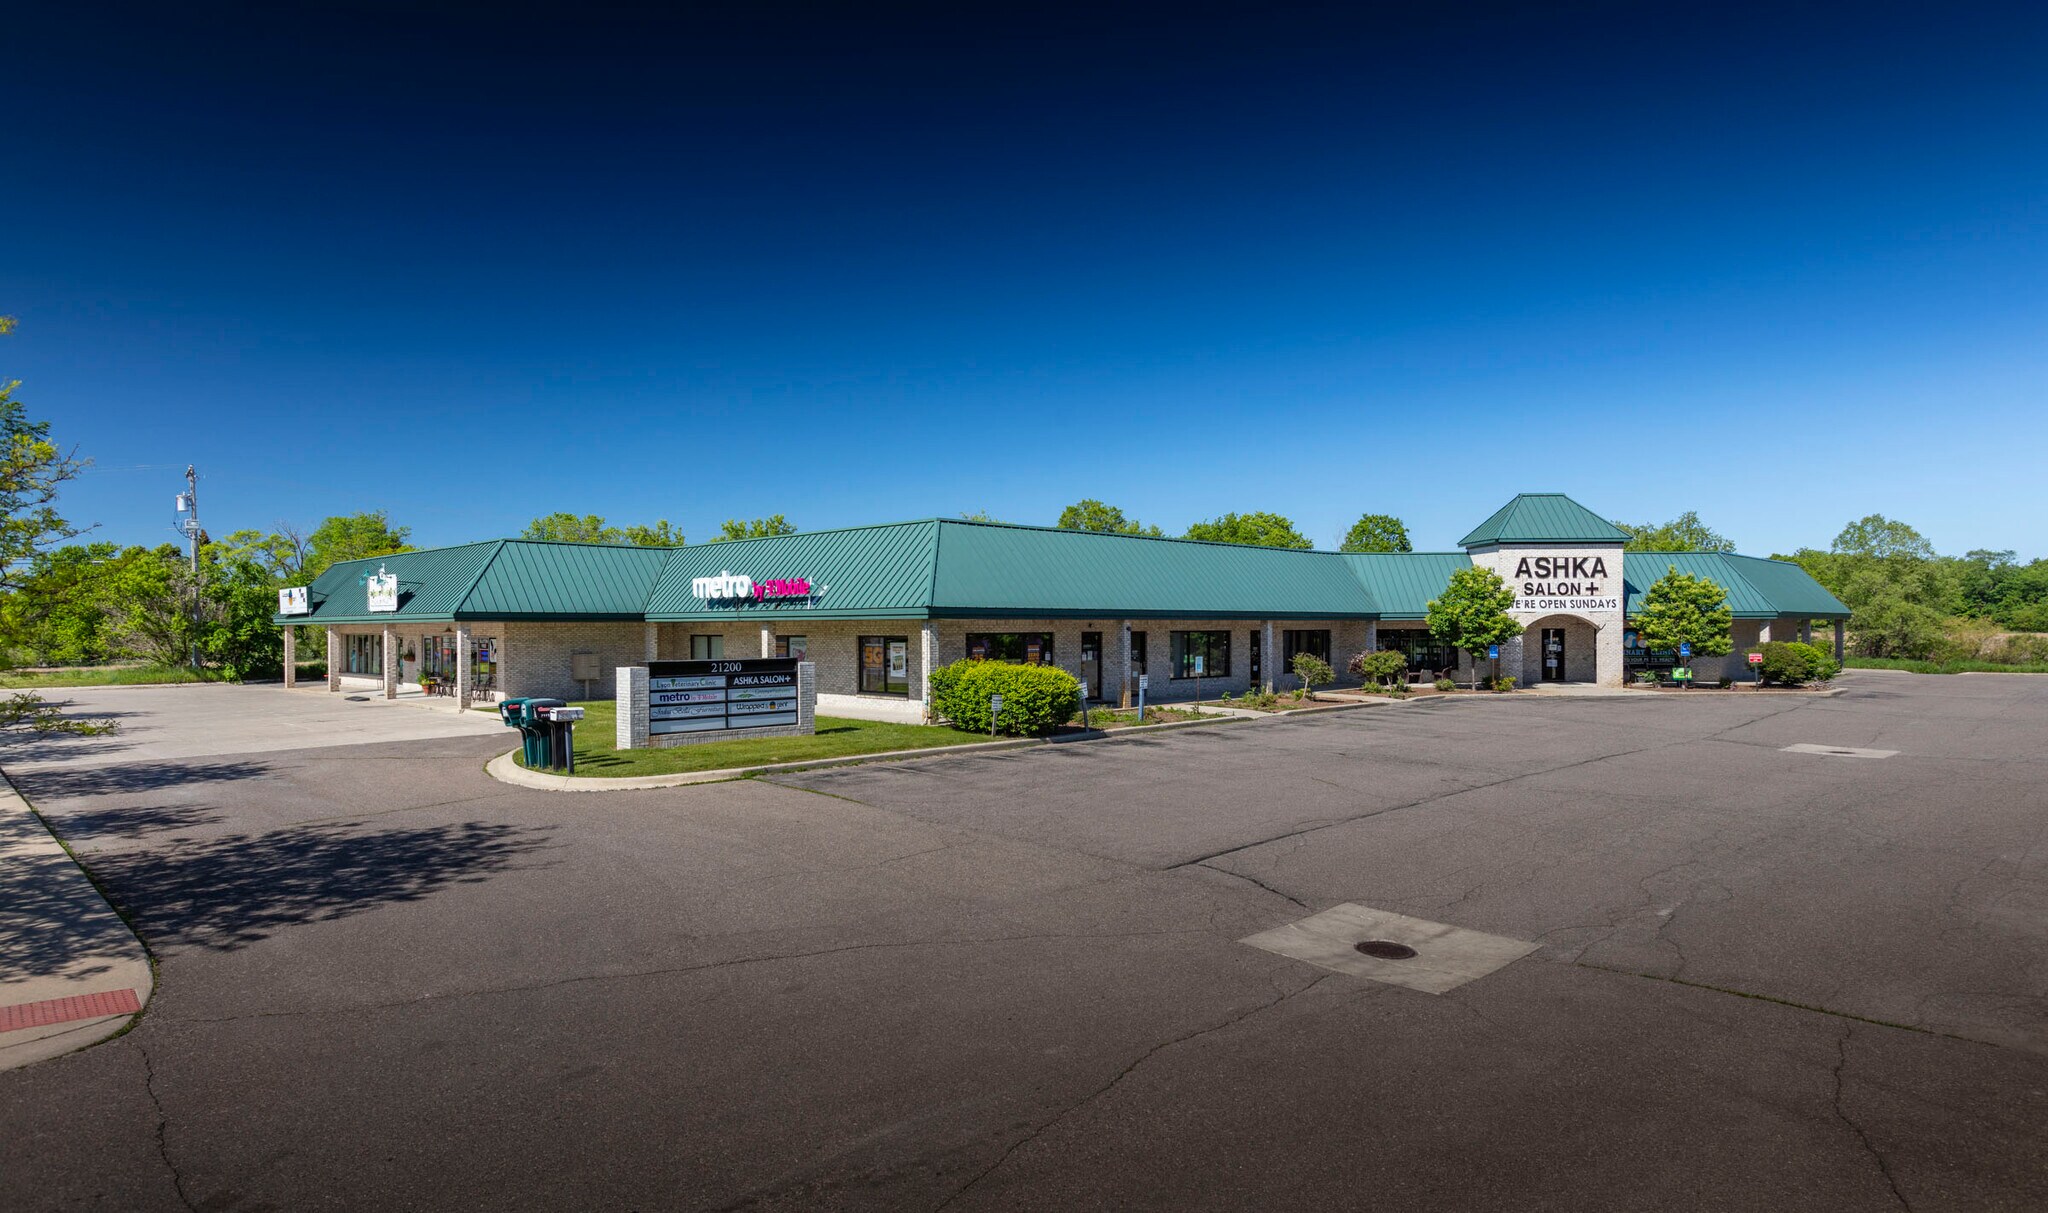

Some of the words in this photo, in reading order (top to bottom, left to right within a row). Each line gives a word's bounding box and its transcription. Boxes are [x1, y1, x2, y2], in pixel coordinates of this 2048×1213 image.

[1515, 557, 1608, 578] ASHKA
[692, 570, 752, 598] metro
[752, 581, 765, 602] by
[1524, 582, 1581, 596] SALON
[1539, 599, 1567, 608] OPEN
[1570, 599, 1617, 608] SUNDAYS
[711, 662, 742, 673] 21200
[700, 678, 716, 686] Clinic
[733, 676, 759, 686] ASHKA
[659, 692, 690, 702] metro
